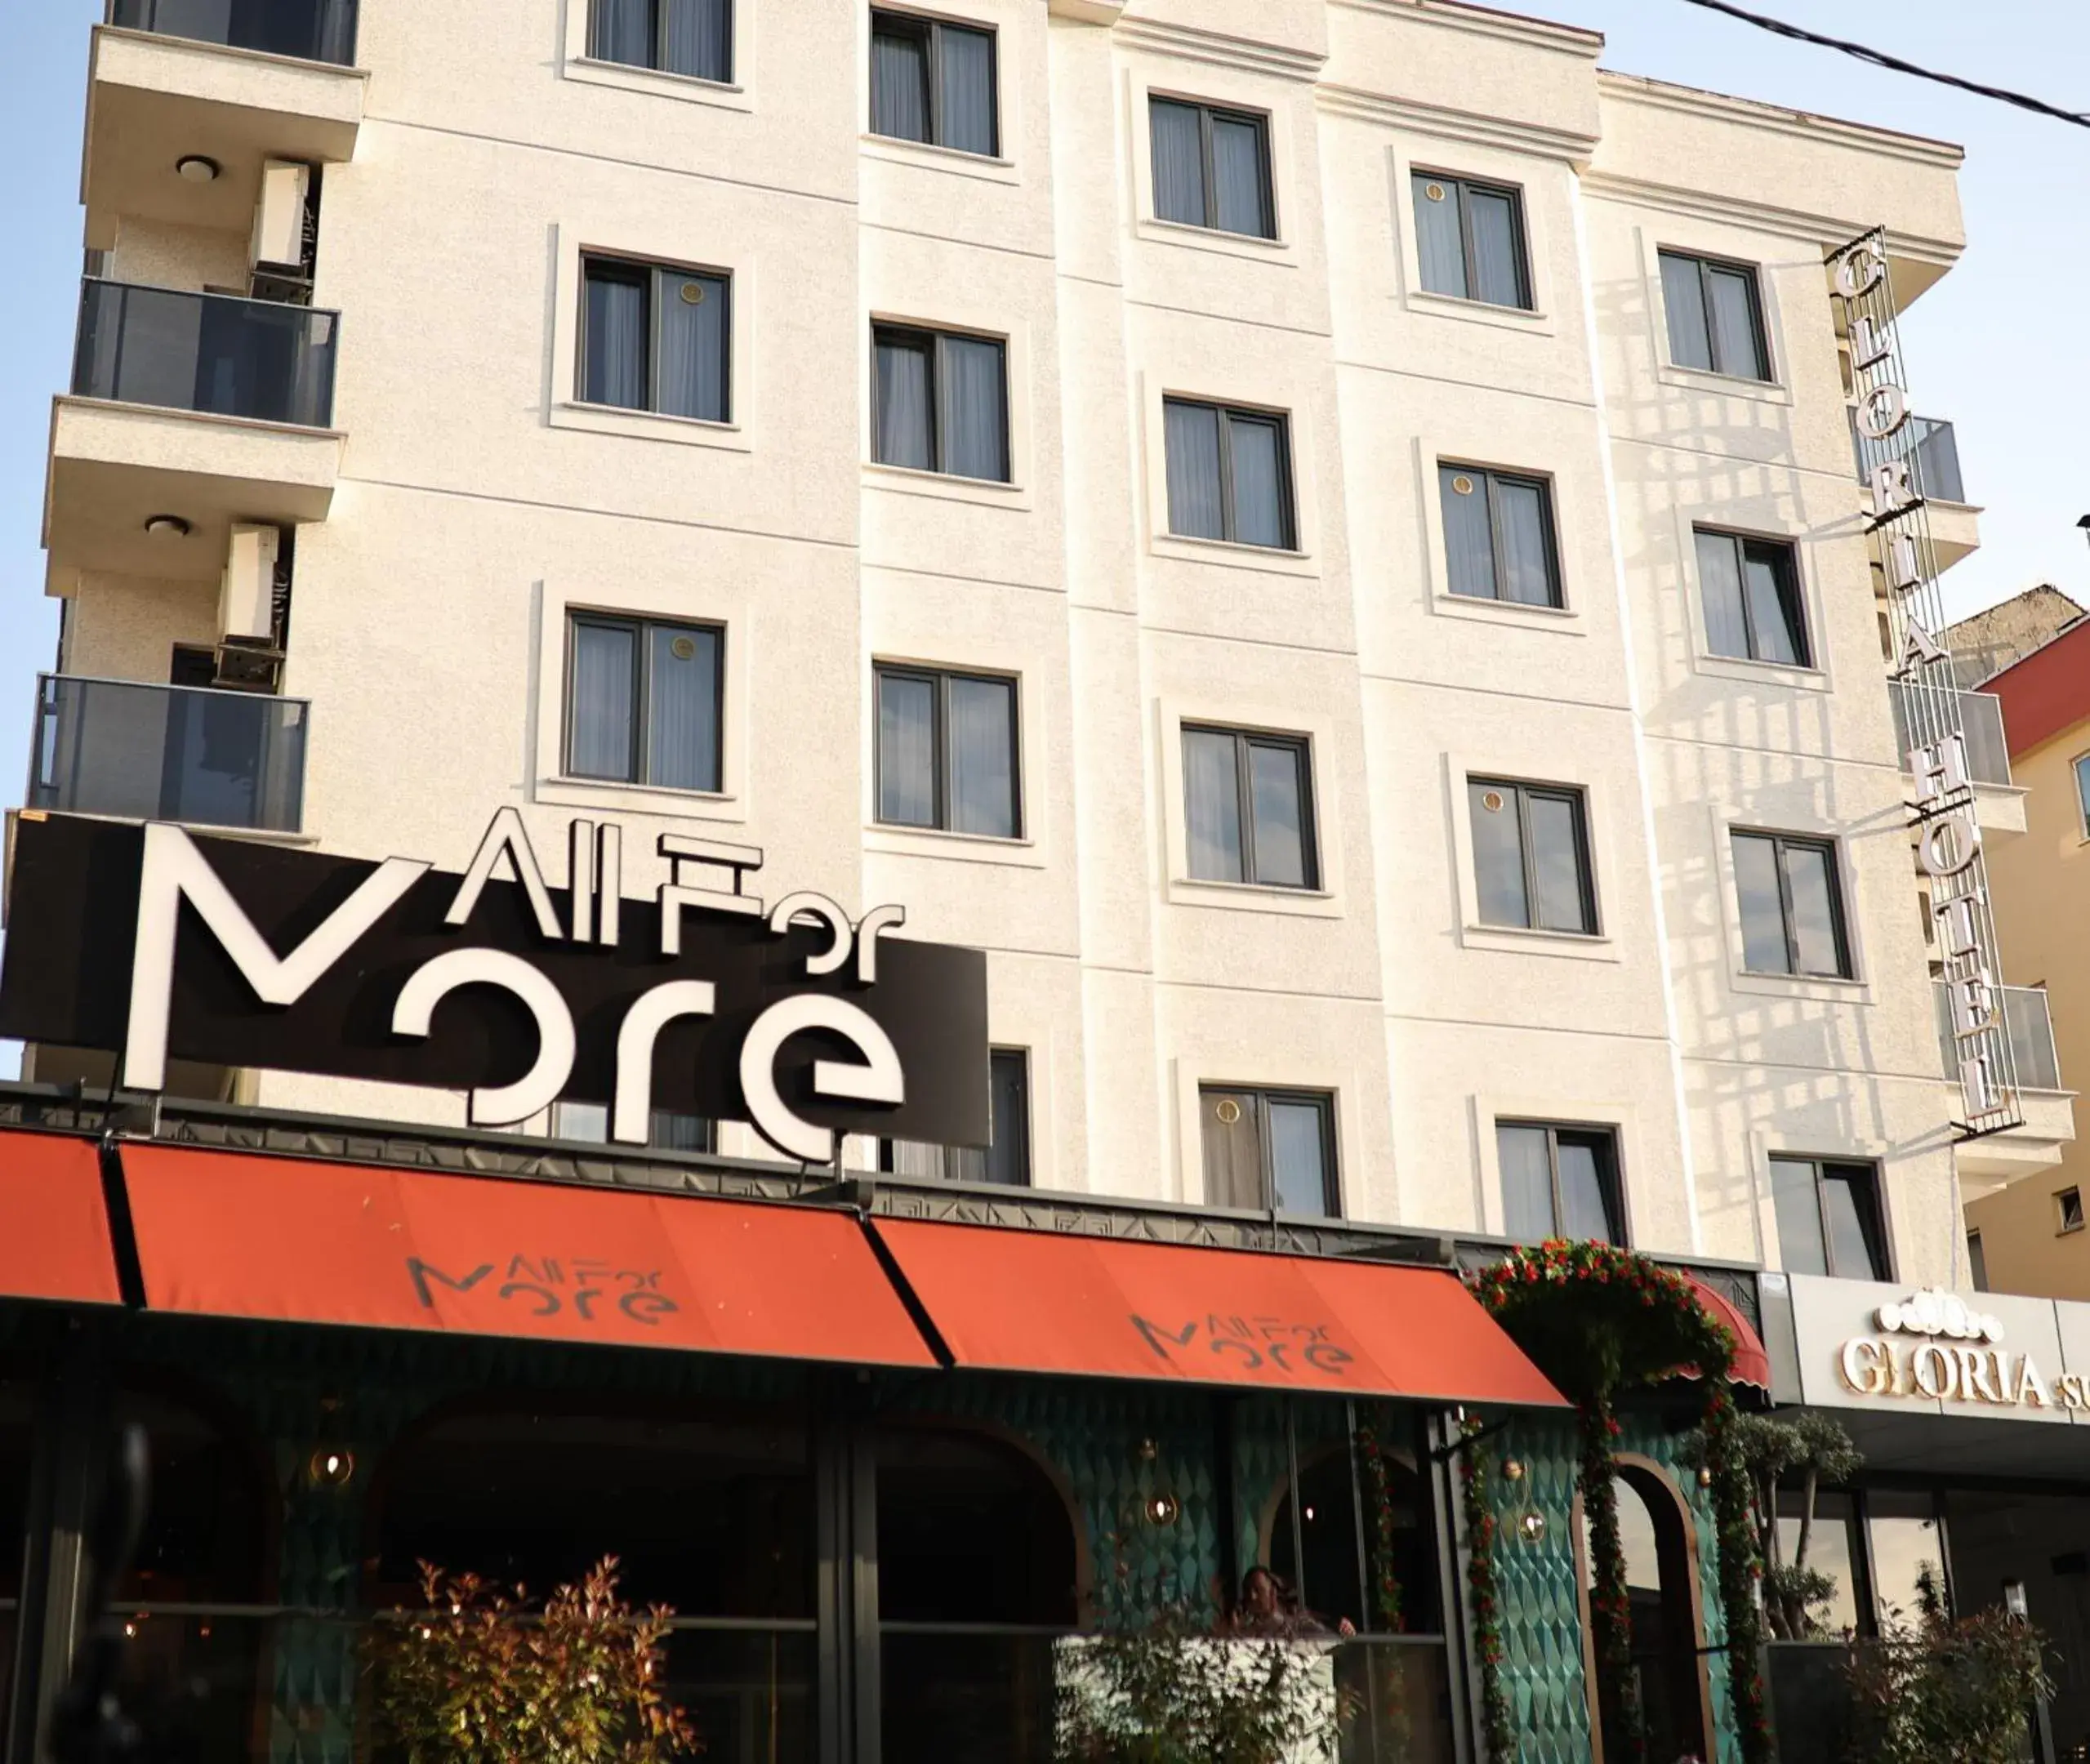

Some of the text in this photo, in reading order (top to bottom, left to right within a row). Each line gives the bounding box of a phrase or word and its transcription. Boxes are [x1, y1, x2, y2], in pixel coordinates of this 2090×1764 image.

[1834, 242, 2012, 1119] GLORIA HOTEL
[444, 805, 907, 984] All For
[123, 821, 905, 1163] More
[405, 1256, 680, 1326] More
[506, 1252, 662, 1290] All For
[1128, 1312, 1356, 1376] More
[1251, 1315, 1330, 1342] For
[1840, 1336, 2055, 1408] GLORIA
